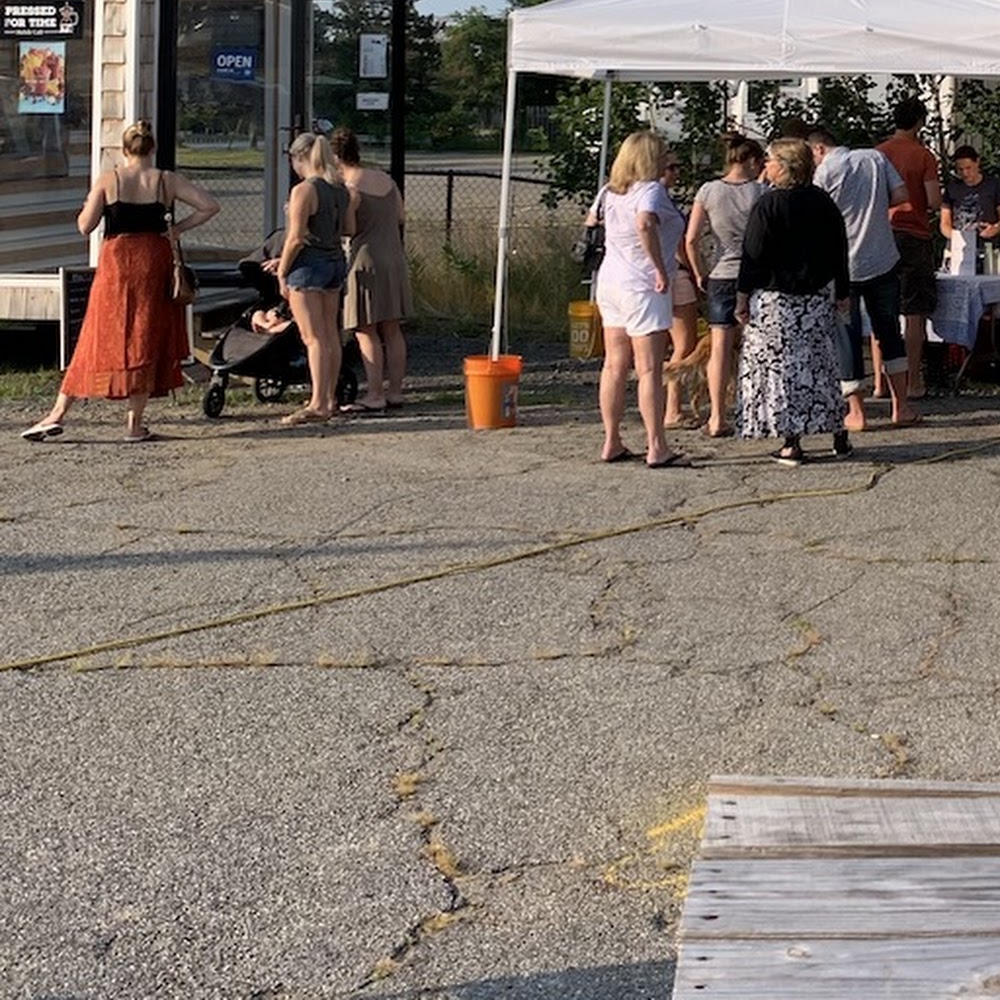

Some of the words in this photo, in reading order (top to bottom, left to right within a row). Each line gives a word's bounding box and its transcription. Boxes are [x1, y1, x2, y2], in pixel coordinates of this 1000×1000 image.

[5, 6, 56, 16] PRESSED
[4, 18, 26, 27] FOR
[28, 18, 57, 27] TIME
[217, 54, 252, 68] OPEN
